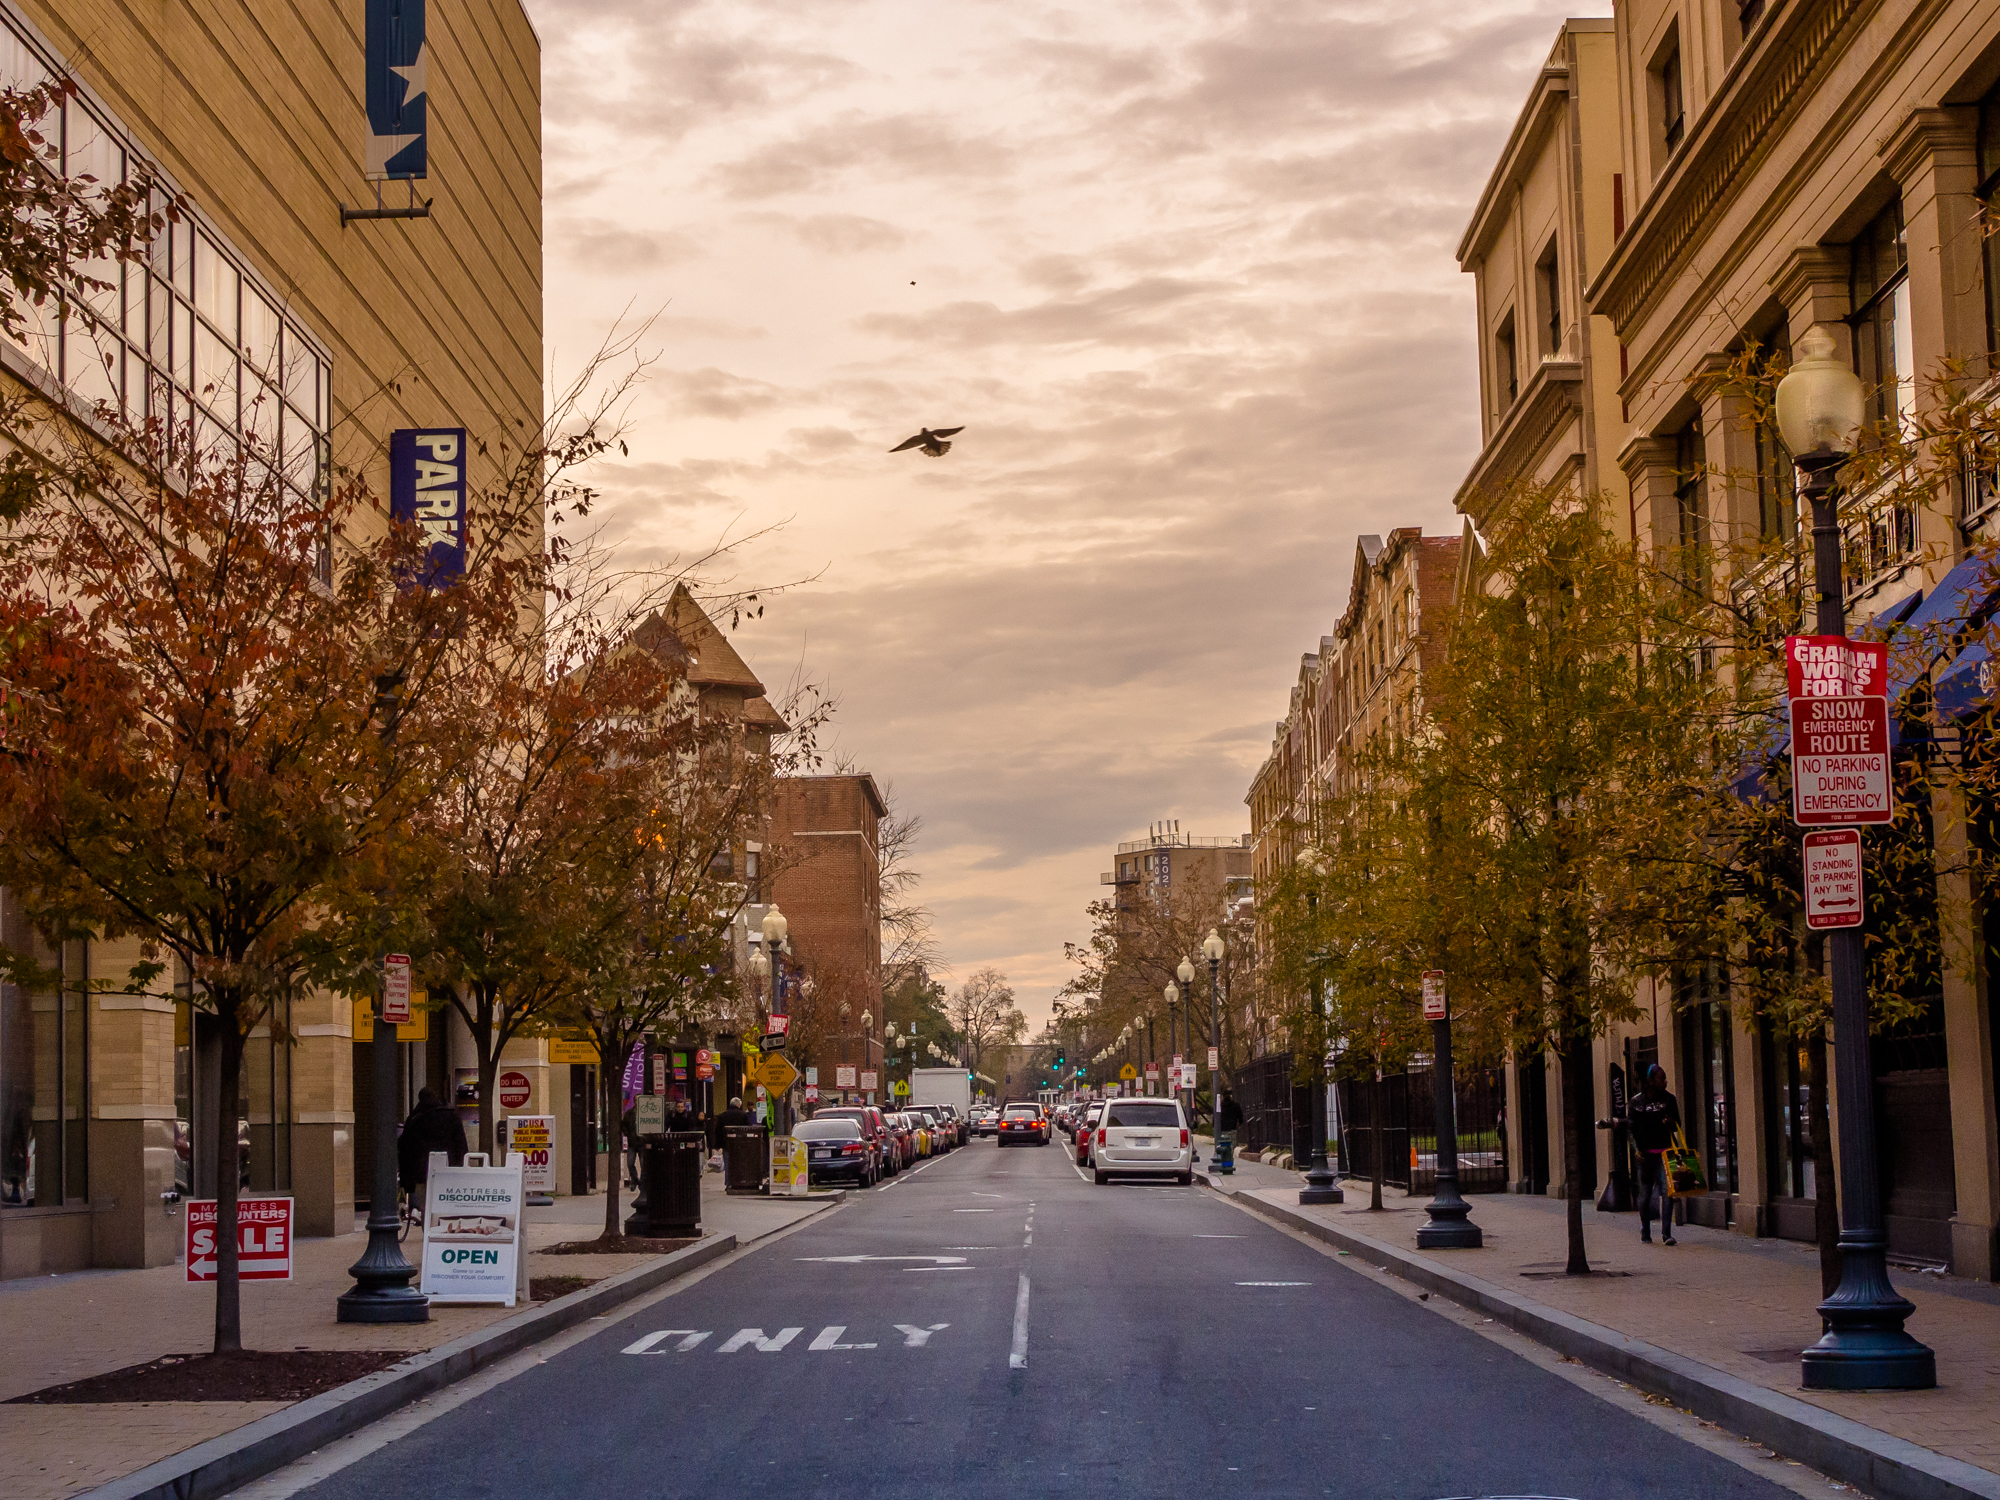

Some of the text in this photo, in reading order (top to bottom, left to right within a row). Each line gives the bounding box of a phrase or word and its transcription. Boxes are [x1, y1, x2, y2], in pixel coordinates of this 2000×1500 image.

[415, 434, 458, 548] PARK
[1794, 645, 1877, 669] GRAHAM
[1800, 661, 1871, 685] WORKS
[1801, 679, 1843, 697] FOR
[1811, 701, 1865, 719] SNOW
[1803, 720, 1875, 733] EMERGENCY
[1810, 734, 1870, 753] ROUTE
[1802, 757, 1880, 773] NO PARKING
[1818, 776, 1866, 791] DURING
[1804, 793, 1881, 810] EMERGENCY
[1825, 848, 1838, 857] NO
[1812, 859, 1853, 871] STANDING
[1810, 871, 1856, 883] OR PARKING
[1813, 884, 1854, 895] ANY TIME
[512, 1078, 525, 1086] NOT
[640, 1117, 661, 1125] PARKING
[438, 1194, 512, 1202] DISCOUNTERS
[445, 1187, 506, 1195] MATTRESS
[191, 1226, 285, 1255] SLE
[441, 1249, 498, 1264] OPEN
[620, 1323, 951, 1355] ONLY
